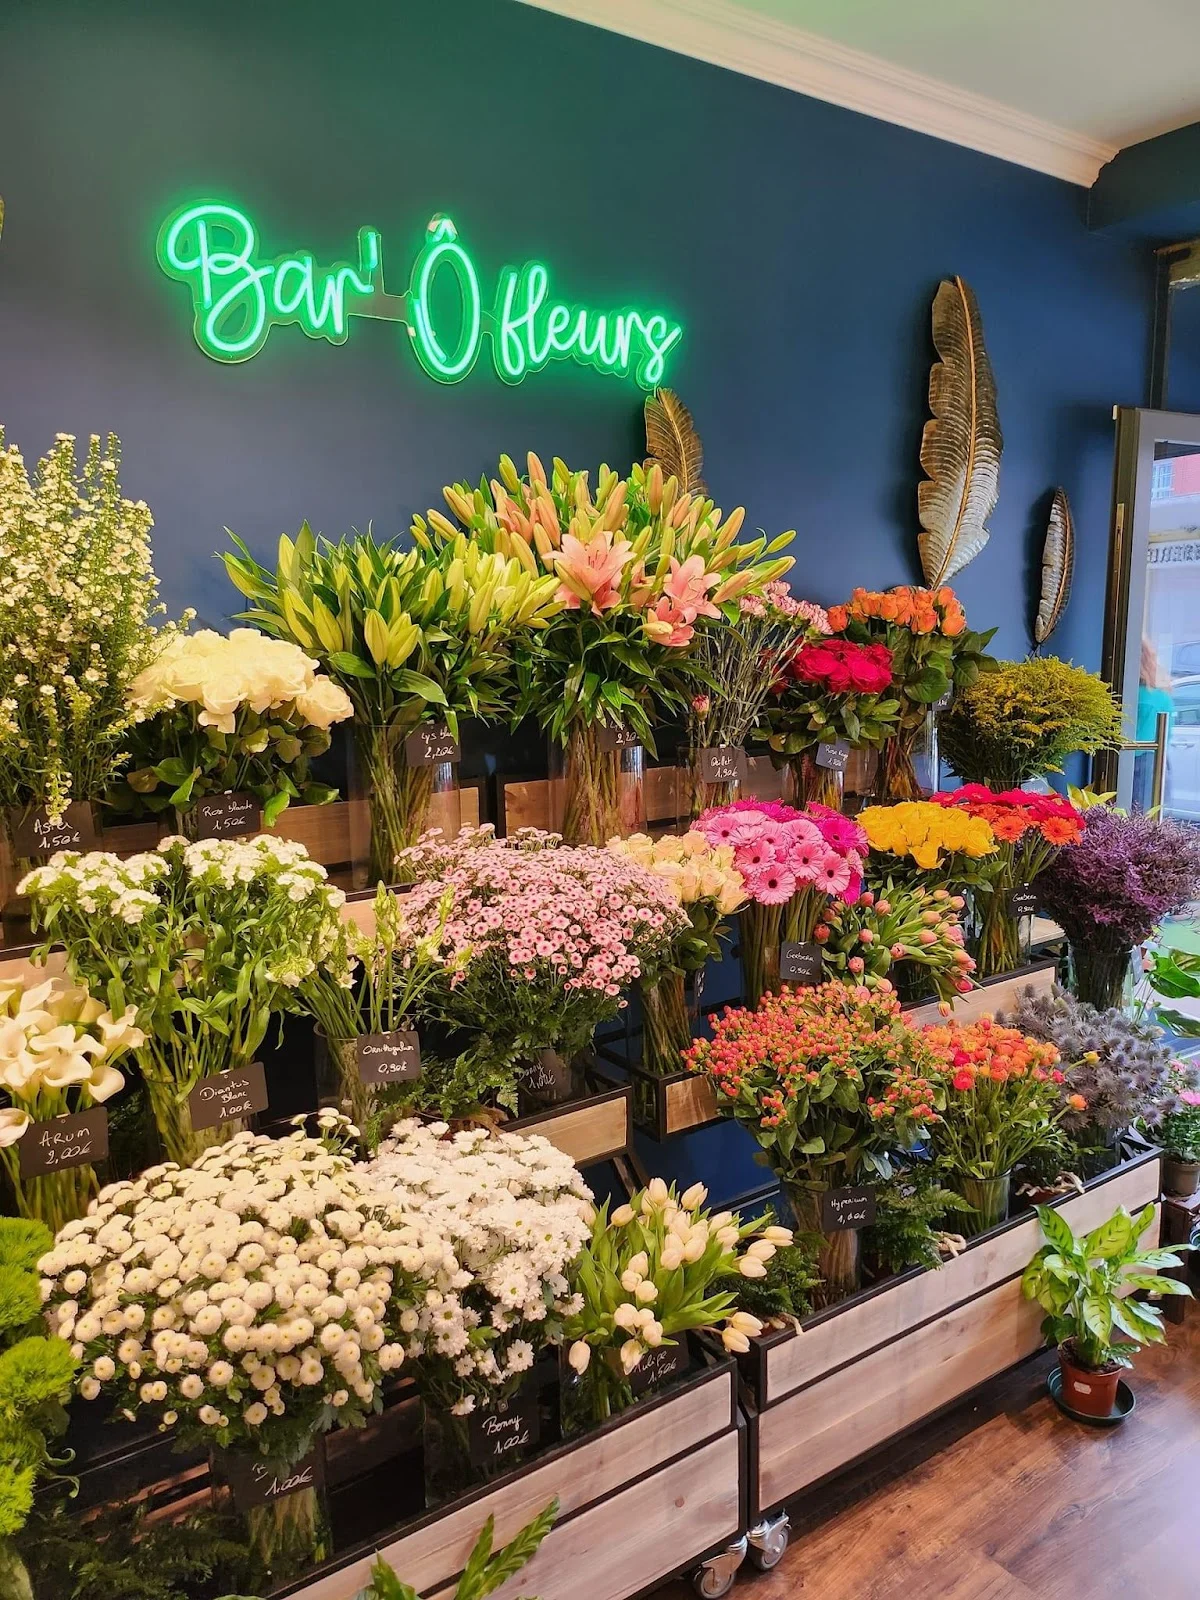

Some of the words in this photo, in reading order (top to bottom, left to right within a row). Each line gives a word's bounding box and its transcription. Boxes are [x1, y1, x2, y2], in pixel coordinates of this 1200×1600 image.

[167, 204, 378, 353] Bar'
[413, 217, 481, 375] Ô
[501, 264, 682, 384] fleurs
[221, 1090, 248, 1104] Blanc
[45, 1140, 94, 1165] 2,00€
[481, 1414, 523, 1436] Bonny
